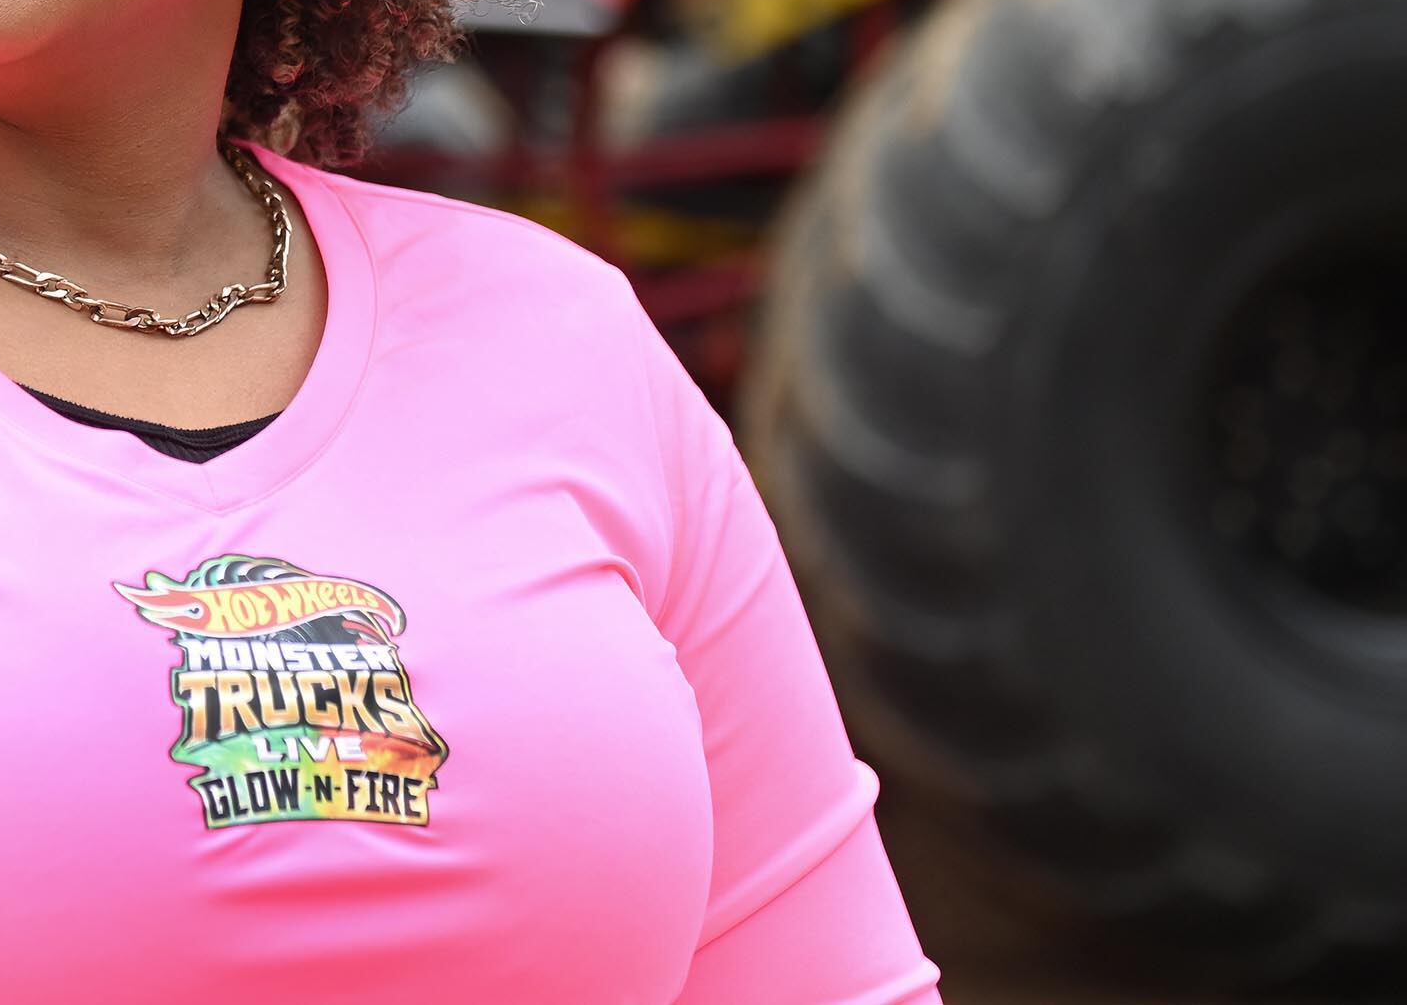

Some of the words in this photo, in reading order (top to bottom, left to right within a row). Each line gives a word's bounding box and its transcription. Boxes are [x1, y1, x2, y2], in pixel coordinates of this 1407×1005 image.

[188, 639, 398, 672] MONSTER
[178, 670, 435, 749] TRUCKS
[252, 735, 368, 763] LIVE
